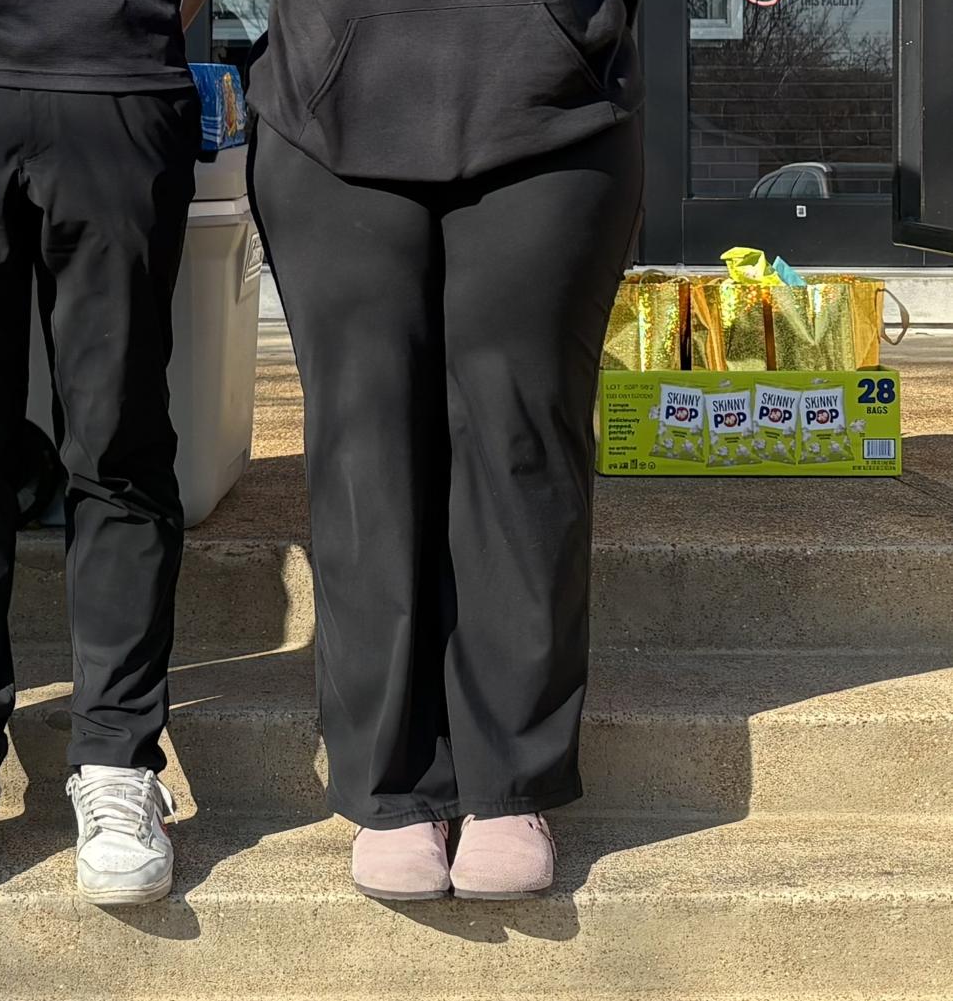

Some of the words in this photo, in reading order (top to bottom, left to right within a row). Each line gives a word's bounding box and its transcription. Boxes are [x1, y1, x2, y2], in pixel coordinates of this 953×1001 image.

[857, 378, 896, 404] 28
[665, 405, 699, 422] POP
[758, 405, 793, 424] POP
[805, 408, 840, 425] POP
[866, 406, 889, 415] BAGS
[713, 411, 747, 429] POP
